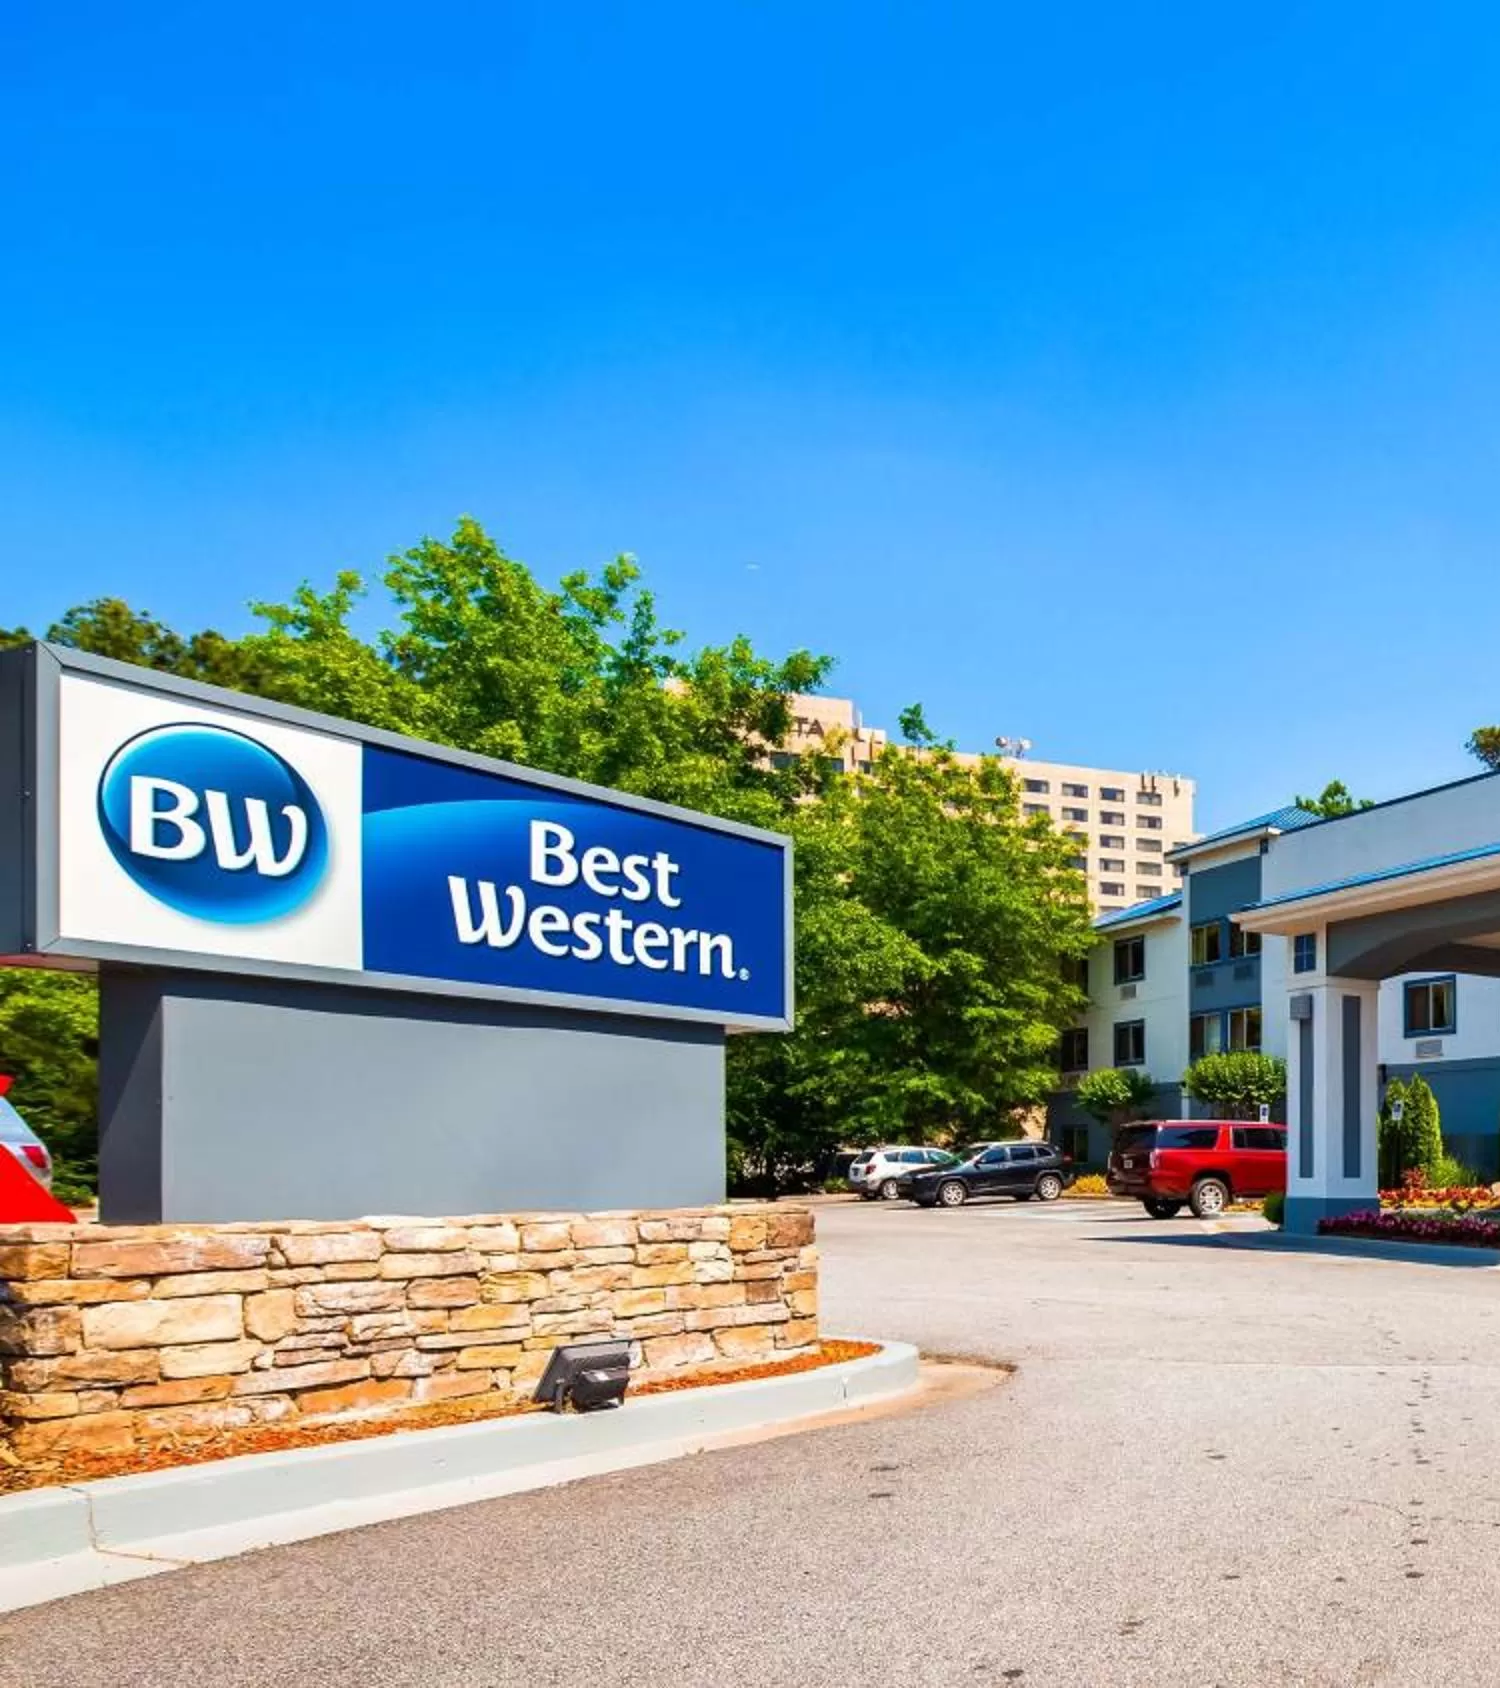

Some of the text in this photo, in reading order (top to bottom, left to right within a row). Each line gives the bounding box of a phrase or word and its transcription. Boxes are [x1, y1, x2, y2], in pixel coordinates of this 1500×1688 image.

[129, 774, 308, 877] BW
[530, 819, 681, 908] Best
[447, 875, 740, 980] Western
